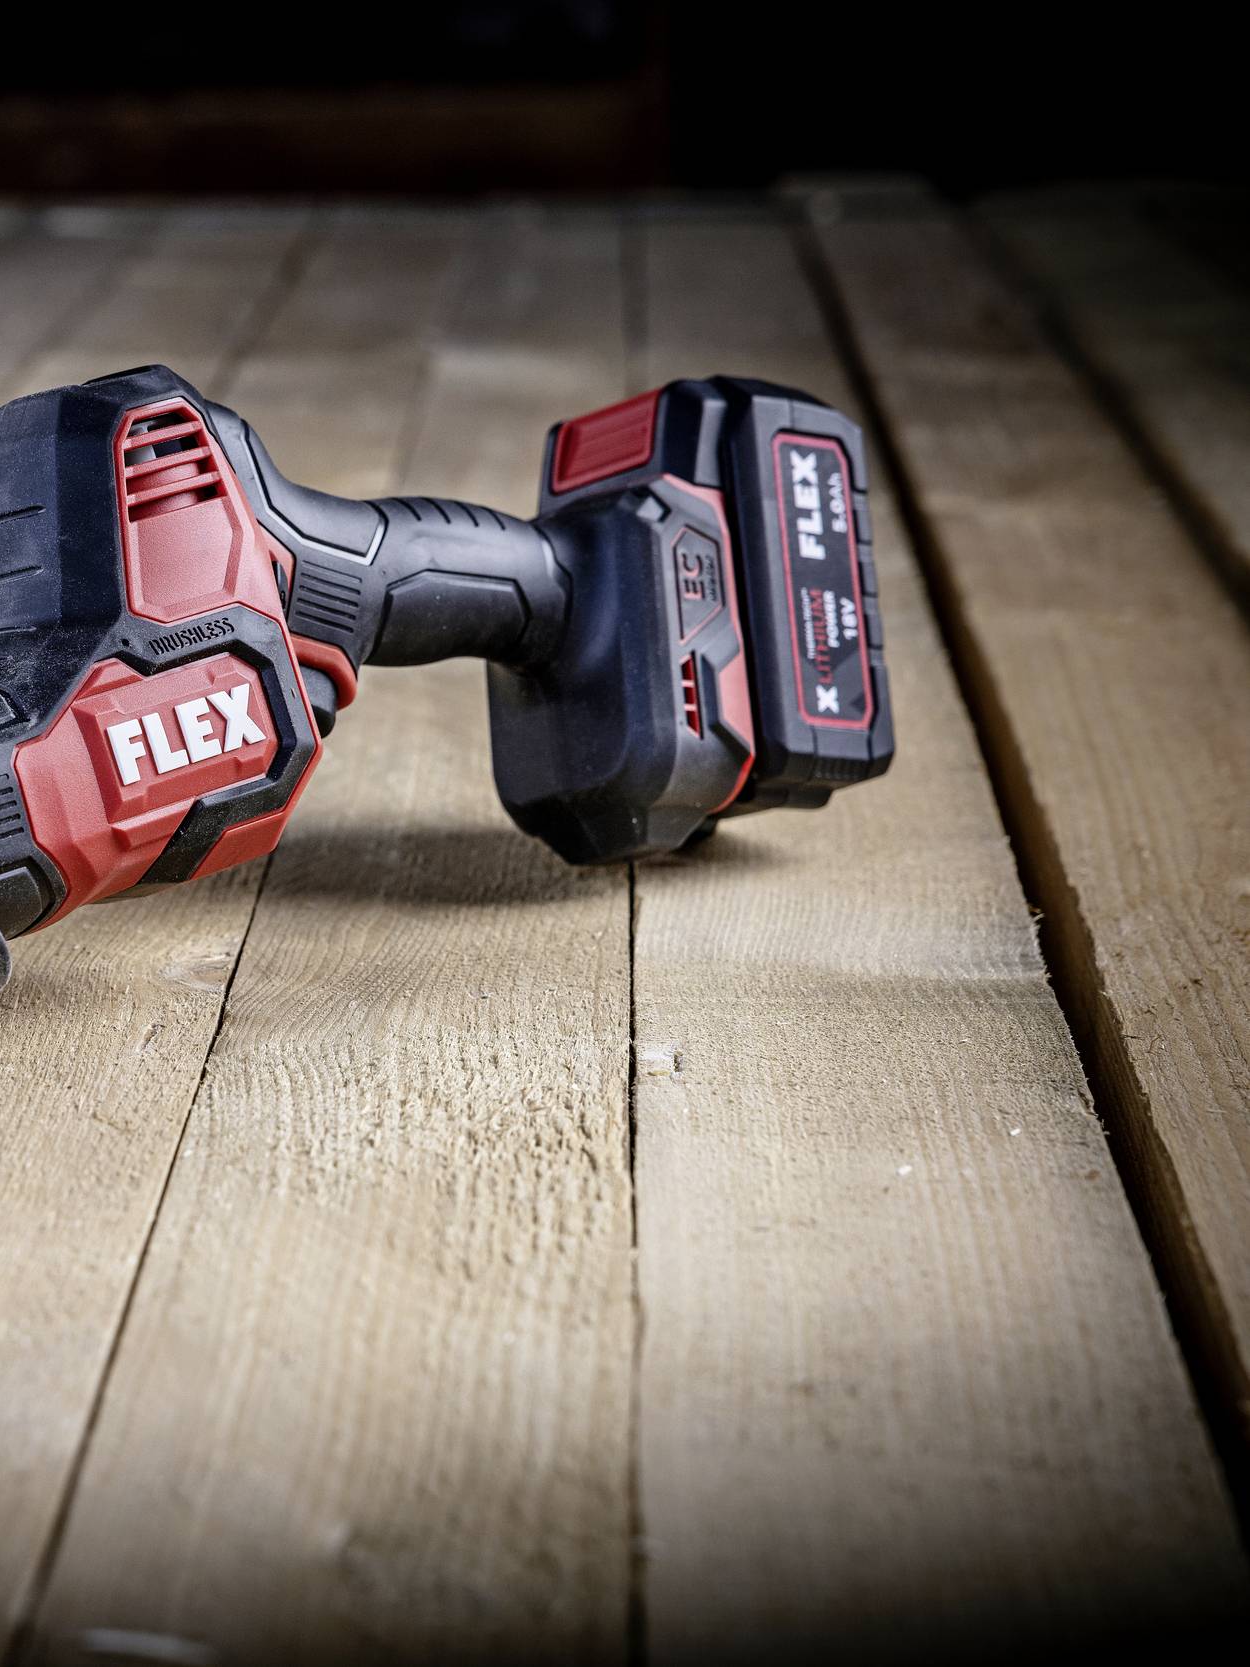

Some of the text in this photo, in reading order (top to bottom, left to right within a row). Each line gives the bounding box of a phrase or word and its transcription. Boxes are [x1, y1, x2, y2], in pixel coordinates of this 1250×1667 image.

[790, 449, 826, 560] FLEX
[827, 472, 848, 533] 5.0Ah
[681, 552, 705, 600] EC
[148, 617, 235, 655] BRUSHLESS
[823, 590, 840, 648] POWER
[839, 597, 858, 640] 18V
[810, 587, 840, 714] X LITHIUM
[107, 683, 267, 786] FLEX
